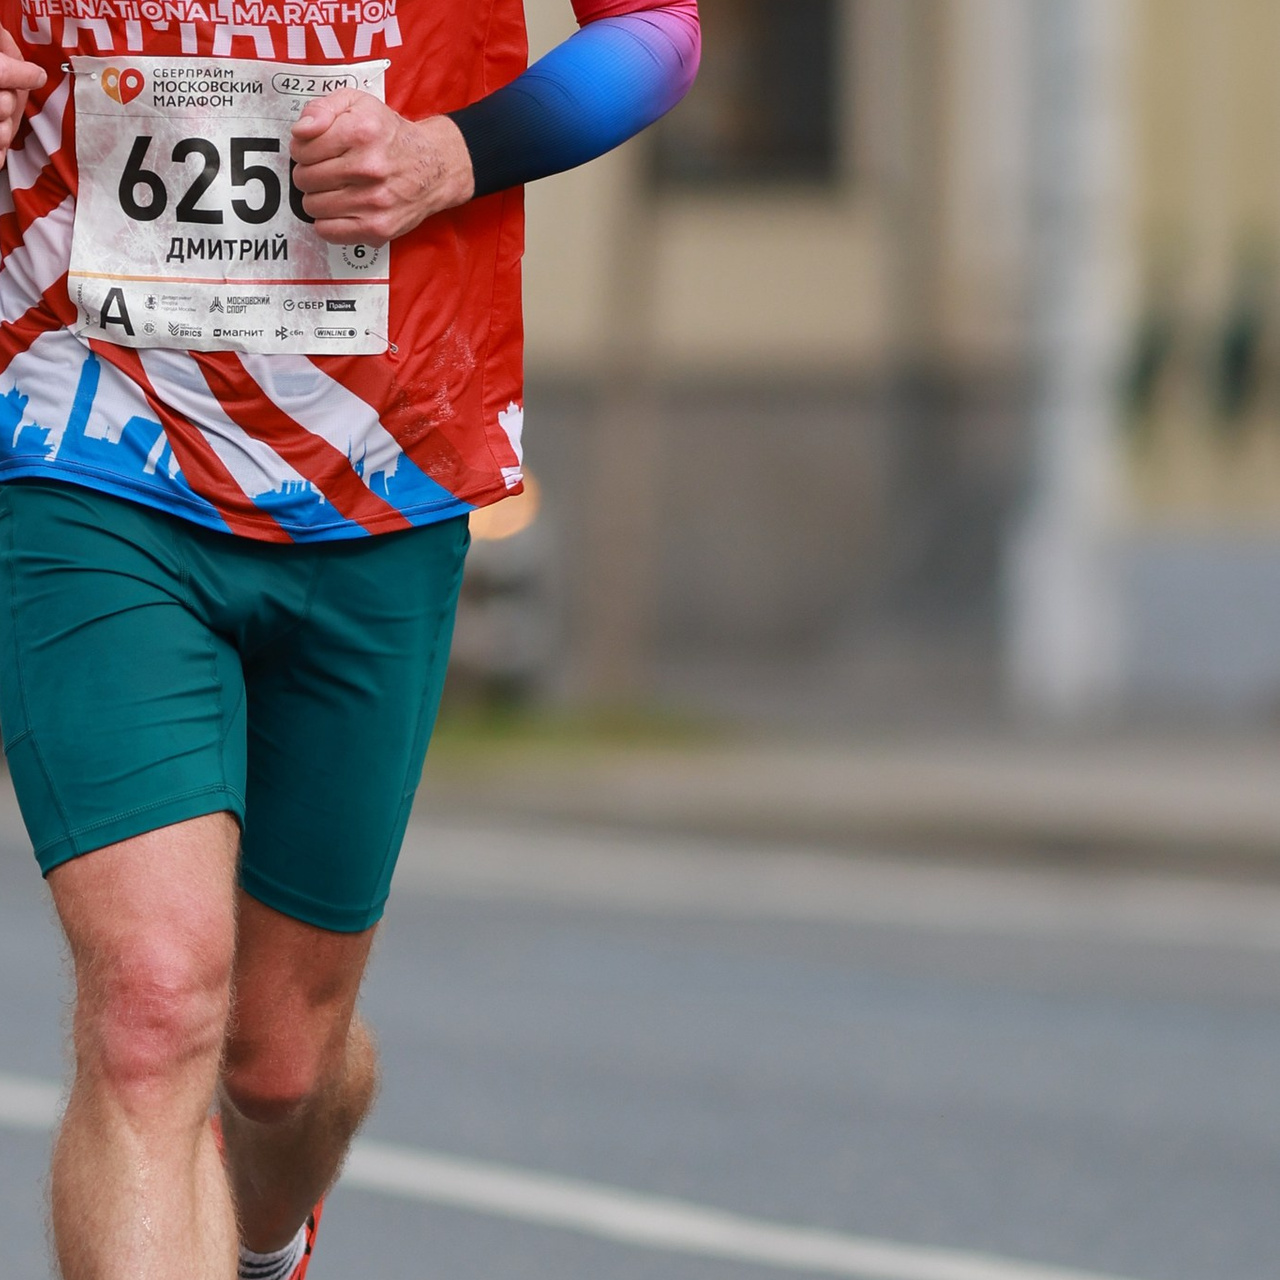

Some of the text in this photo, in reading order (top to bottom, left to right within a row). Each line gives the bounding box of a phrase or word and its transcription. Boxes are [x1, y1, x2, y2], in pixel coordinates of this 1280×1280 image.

[153, 67, 234, 78] СБЕРПРАЙМ
[153, 80, 263, 94] МОСКОВСКИЙ
[281, 77, 315, 92] 42,2
[153, 95, 233, 107] МАРАФОН
[166, 234, 289, 263] ДМИТРИЙ
[354, 244, 366, 259] 6
[227, 295, 270, 305] МОСКОВСКИЙ
[297, 301, 324, 310] СБЕР
[227, 305, 247, 314] СПОРТ
[180, 329, 202, 337] BRICS
[222, 328, 264, 337] магнит
